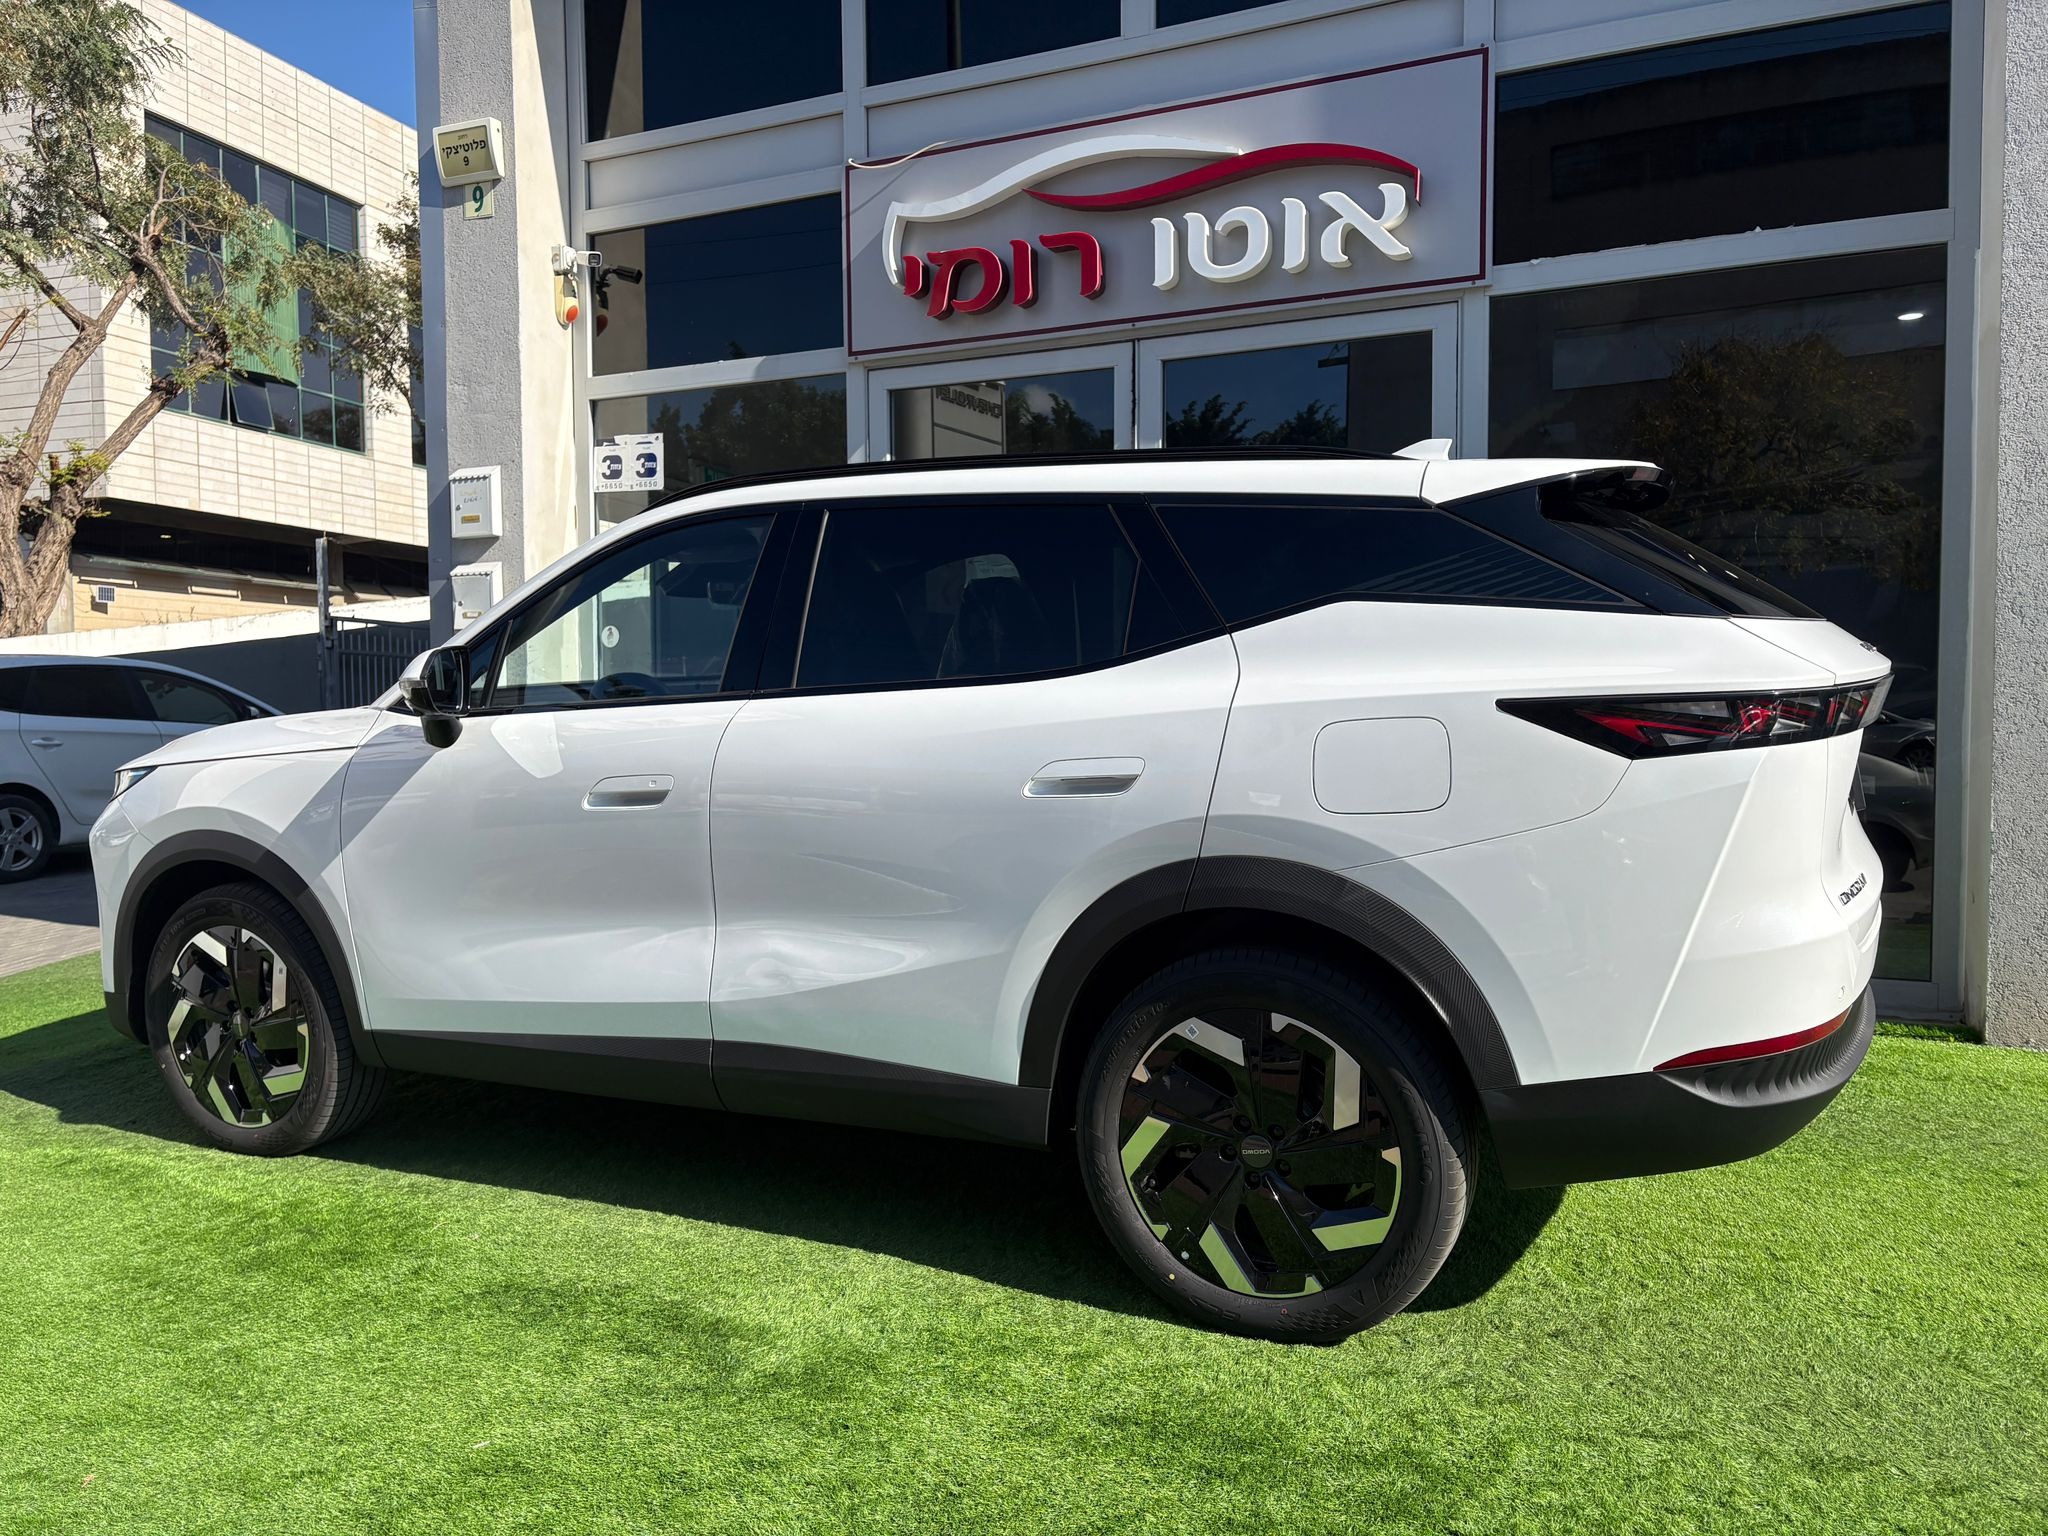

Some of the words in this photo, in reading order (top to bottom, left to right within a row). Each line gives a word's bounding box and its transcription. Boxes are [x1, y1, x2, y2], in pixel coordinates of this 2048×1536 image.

[441, 138, 487, 159] פלוטיצקי
[463, 156, 470, 167] 9
[472, 185, 484, 213] 9
[1151, 182, 1412, 291] אוטו
[903, 230, 1104, 320] רומי
